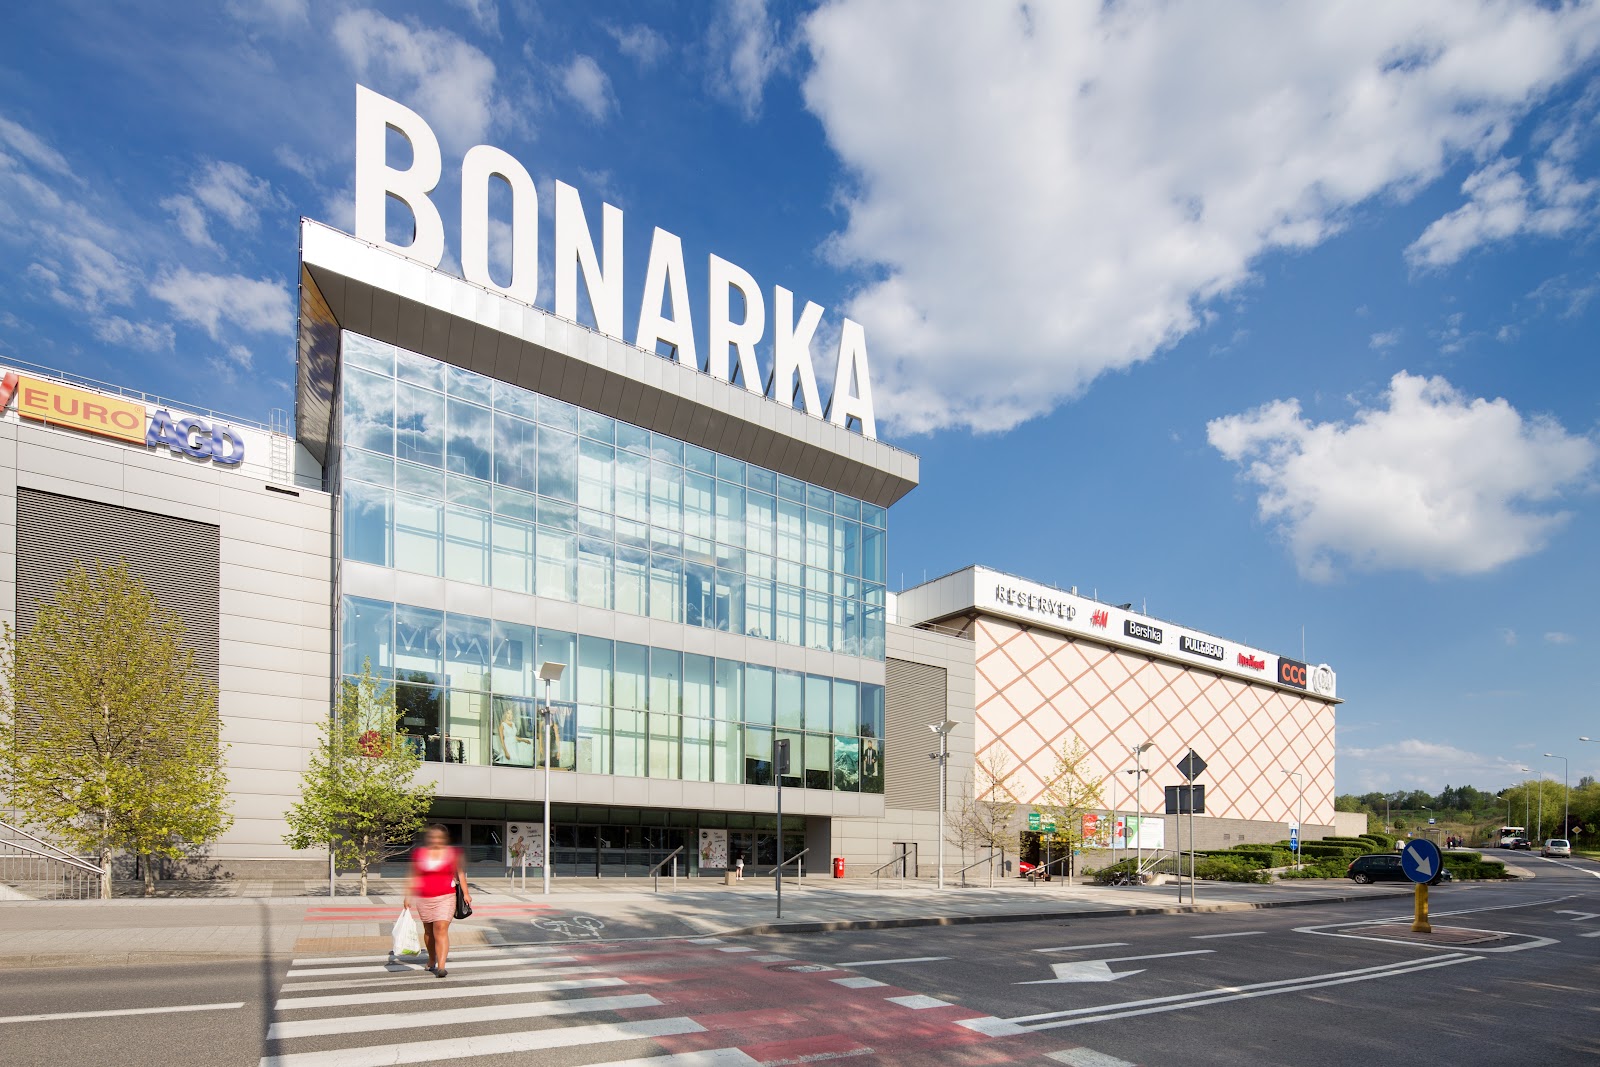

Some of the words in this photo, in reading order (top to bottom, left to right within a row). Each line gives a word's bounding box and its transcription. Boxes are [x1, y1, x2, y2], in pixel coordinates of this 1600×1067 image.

[355, 83, 877, 441] BONARKA
[24, 387, 140, 430] EURO
[146, 409, 245, 465] AGD
[996, 584, 1077, 619] RESERVED
[1092, 609, 1109, 628] H&M
[1129, 620, 1161, 642] Bershka
[1184, 637, 1223, 659] PULL&BEAR
[1281, 663, 1306, 686] CCC
